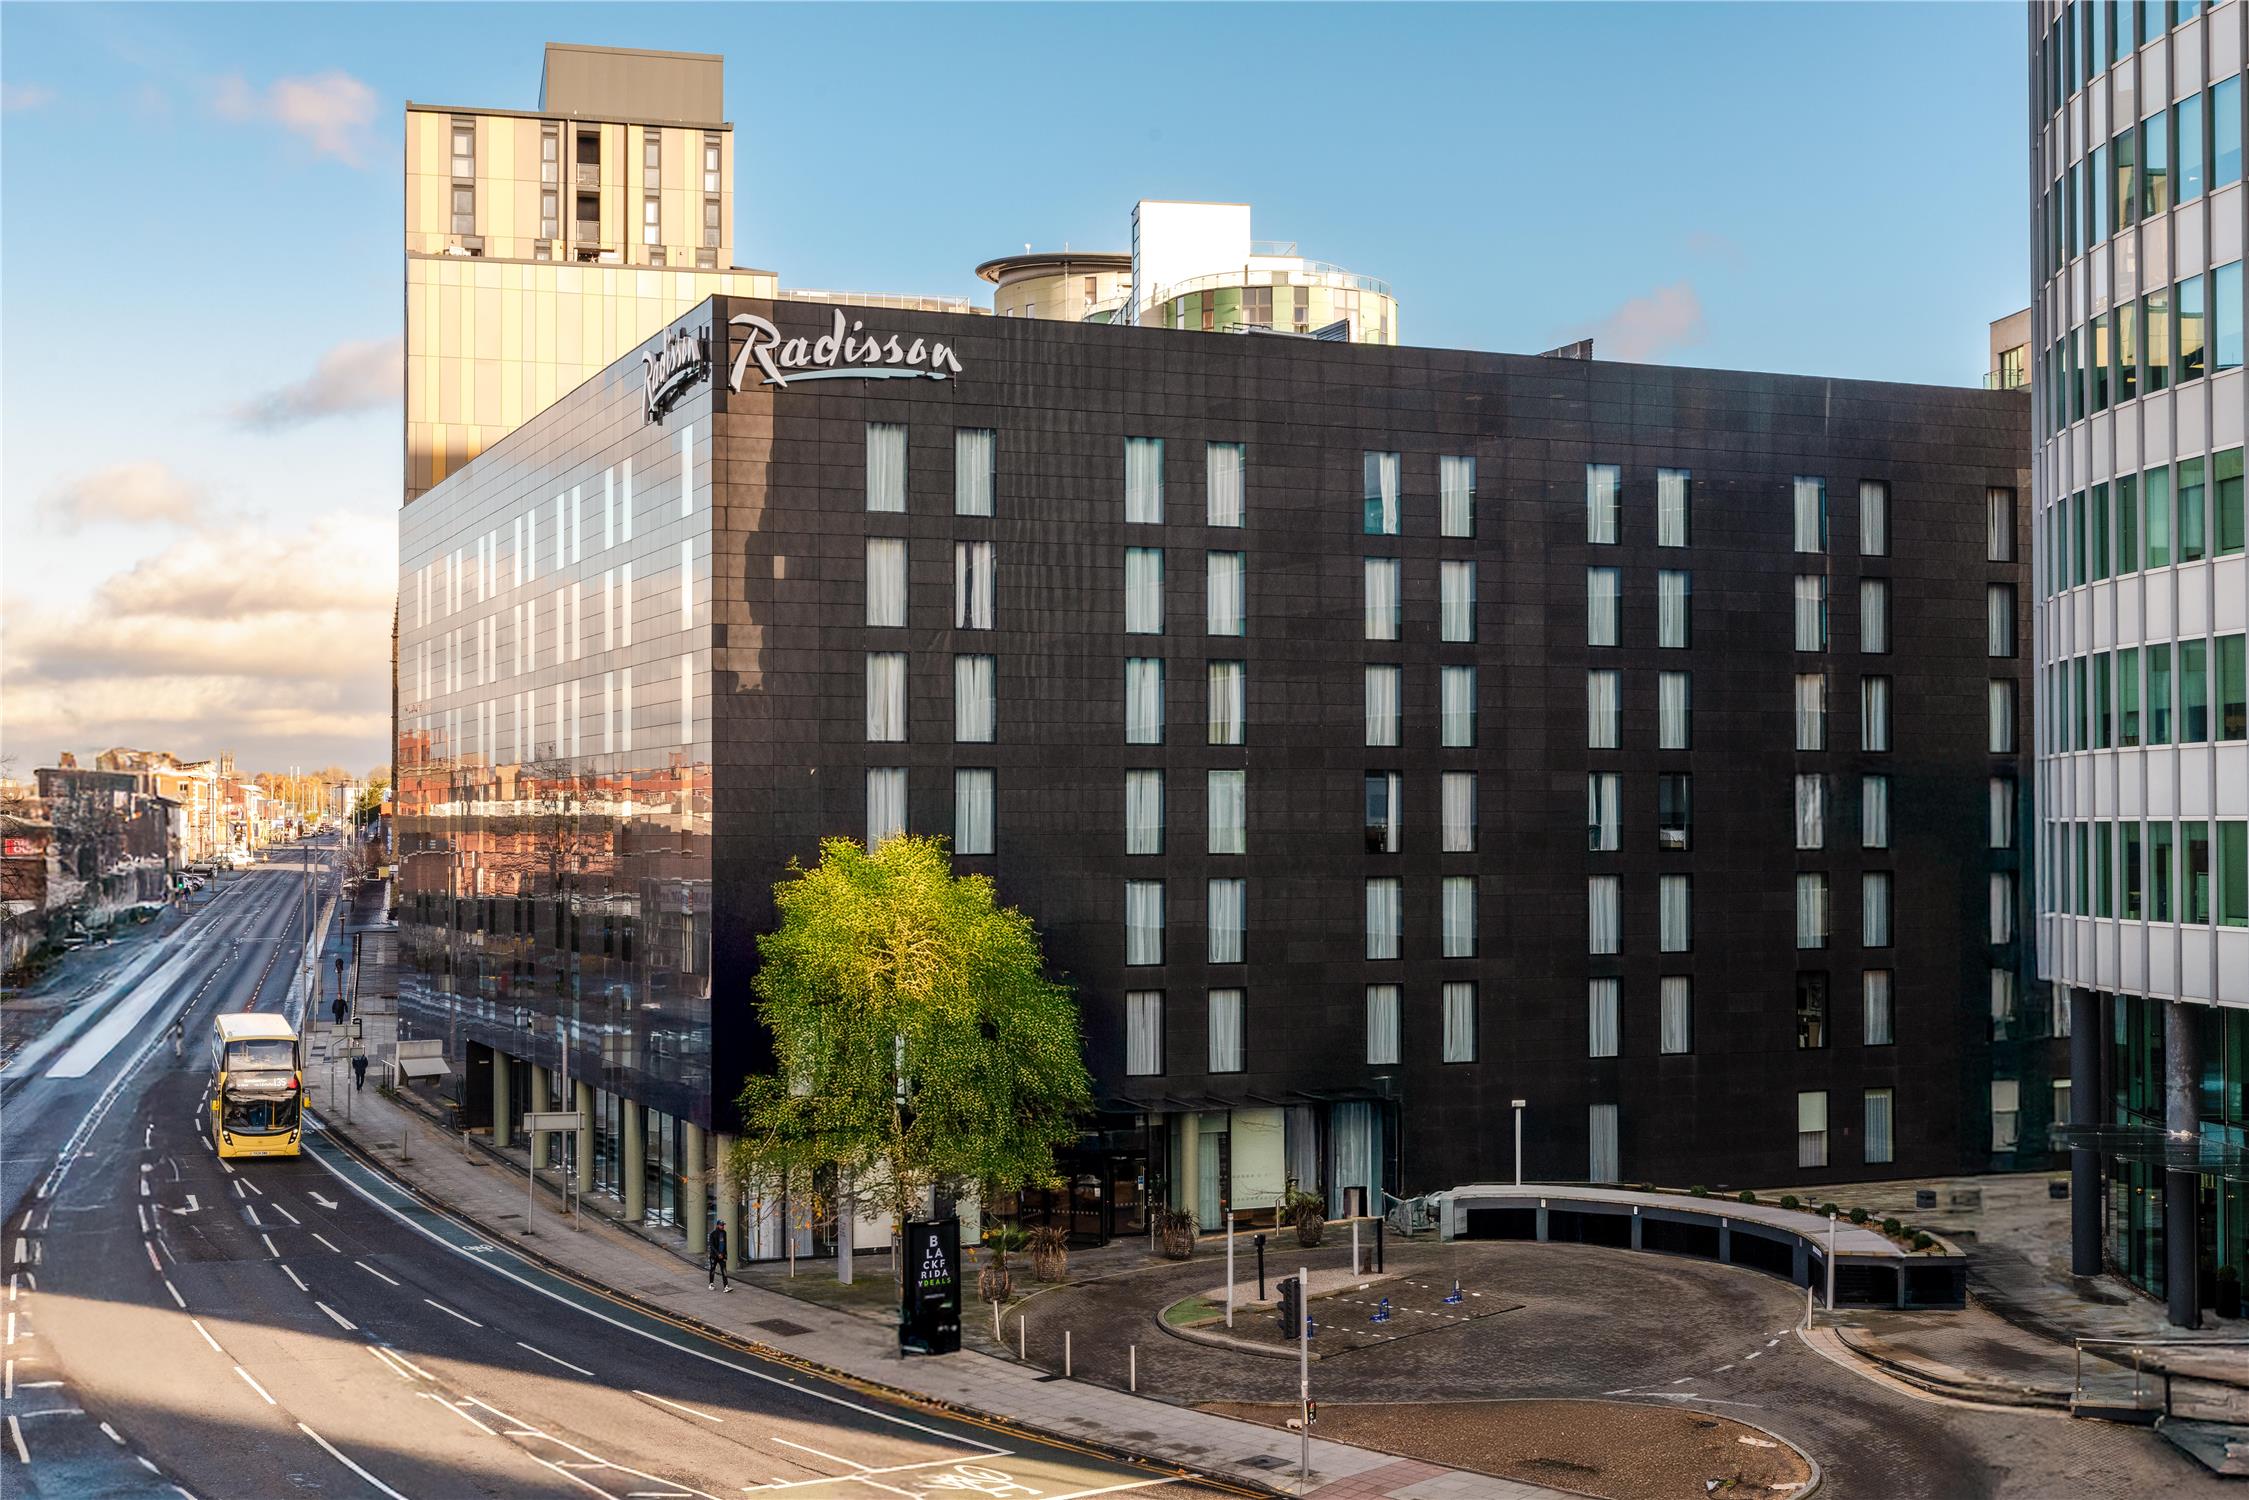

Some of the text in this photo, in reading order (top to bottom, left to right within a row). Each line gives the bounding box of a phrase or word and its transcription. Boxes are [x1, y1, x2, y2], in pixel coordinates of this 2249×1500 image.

[728, 308, 963, 393] Radisson
[641, 326, 701, 426] Radisson
[273, 1077, 287, 1087] 135
[929, 1235, 938, 1248] B
[926, 1247, 943, 1259] LA
[923, 1259, 946, 1270] CKF
[921, 1269, 948, 1279] RIDA
